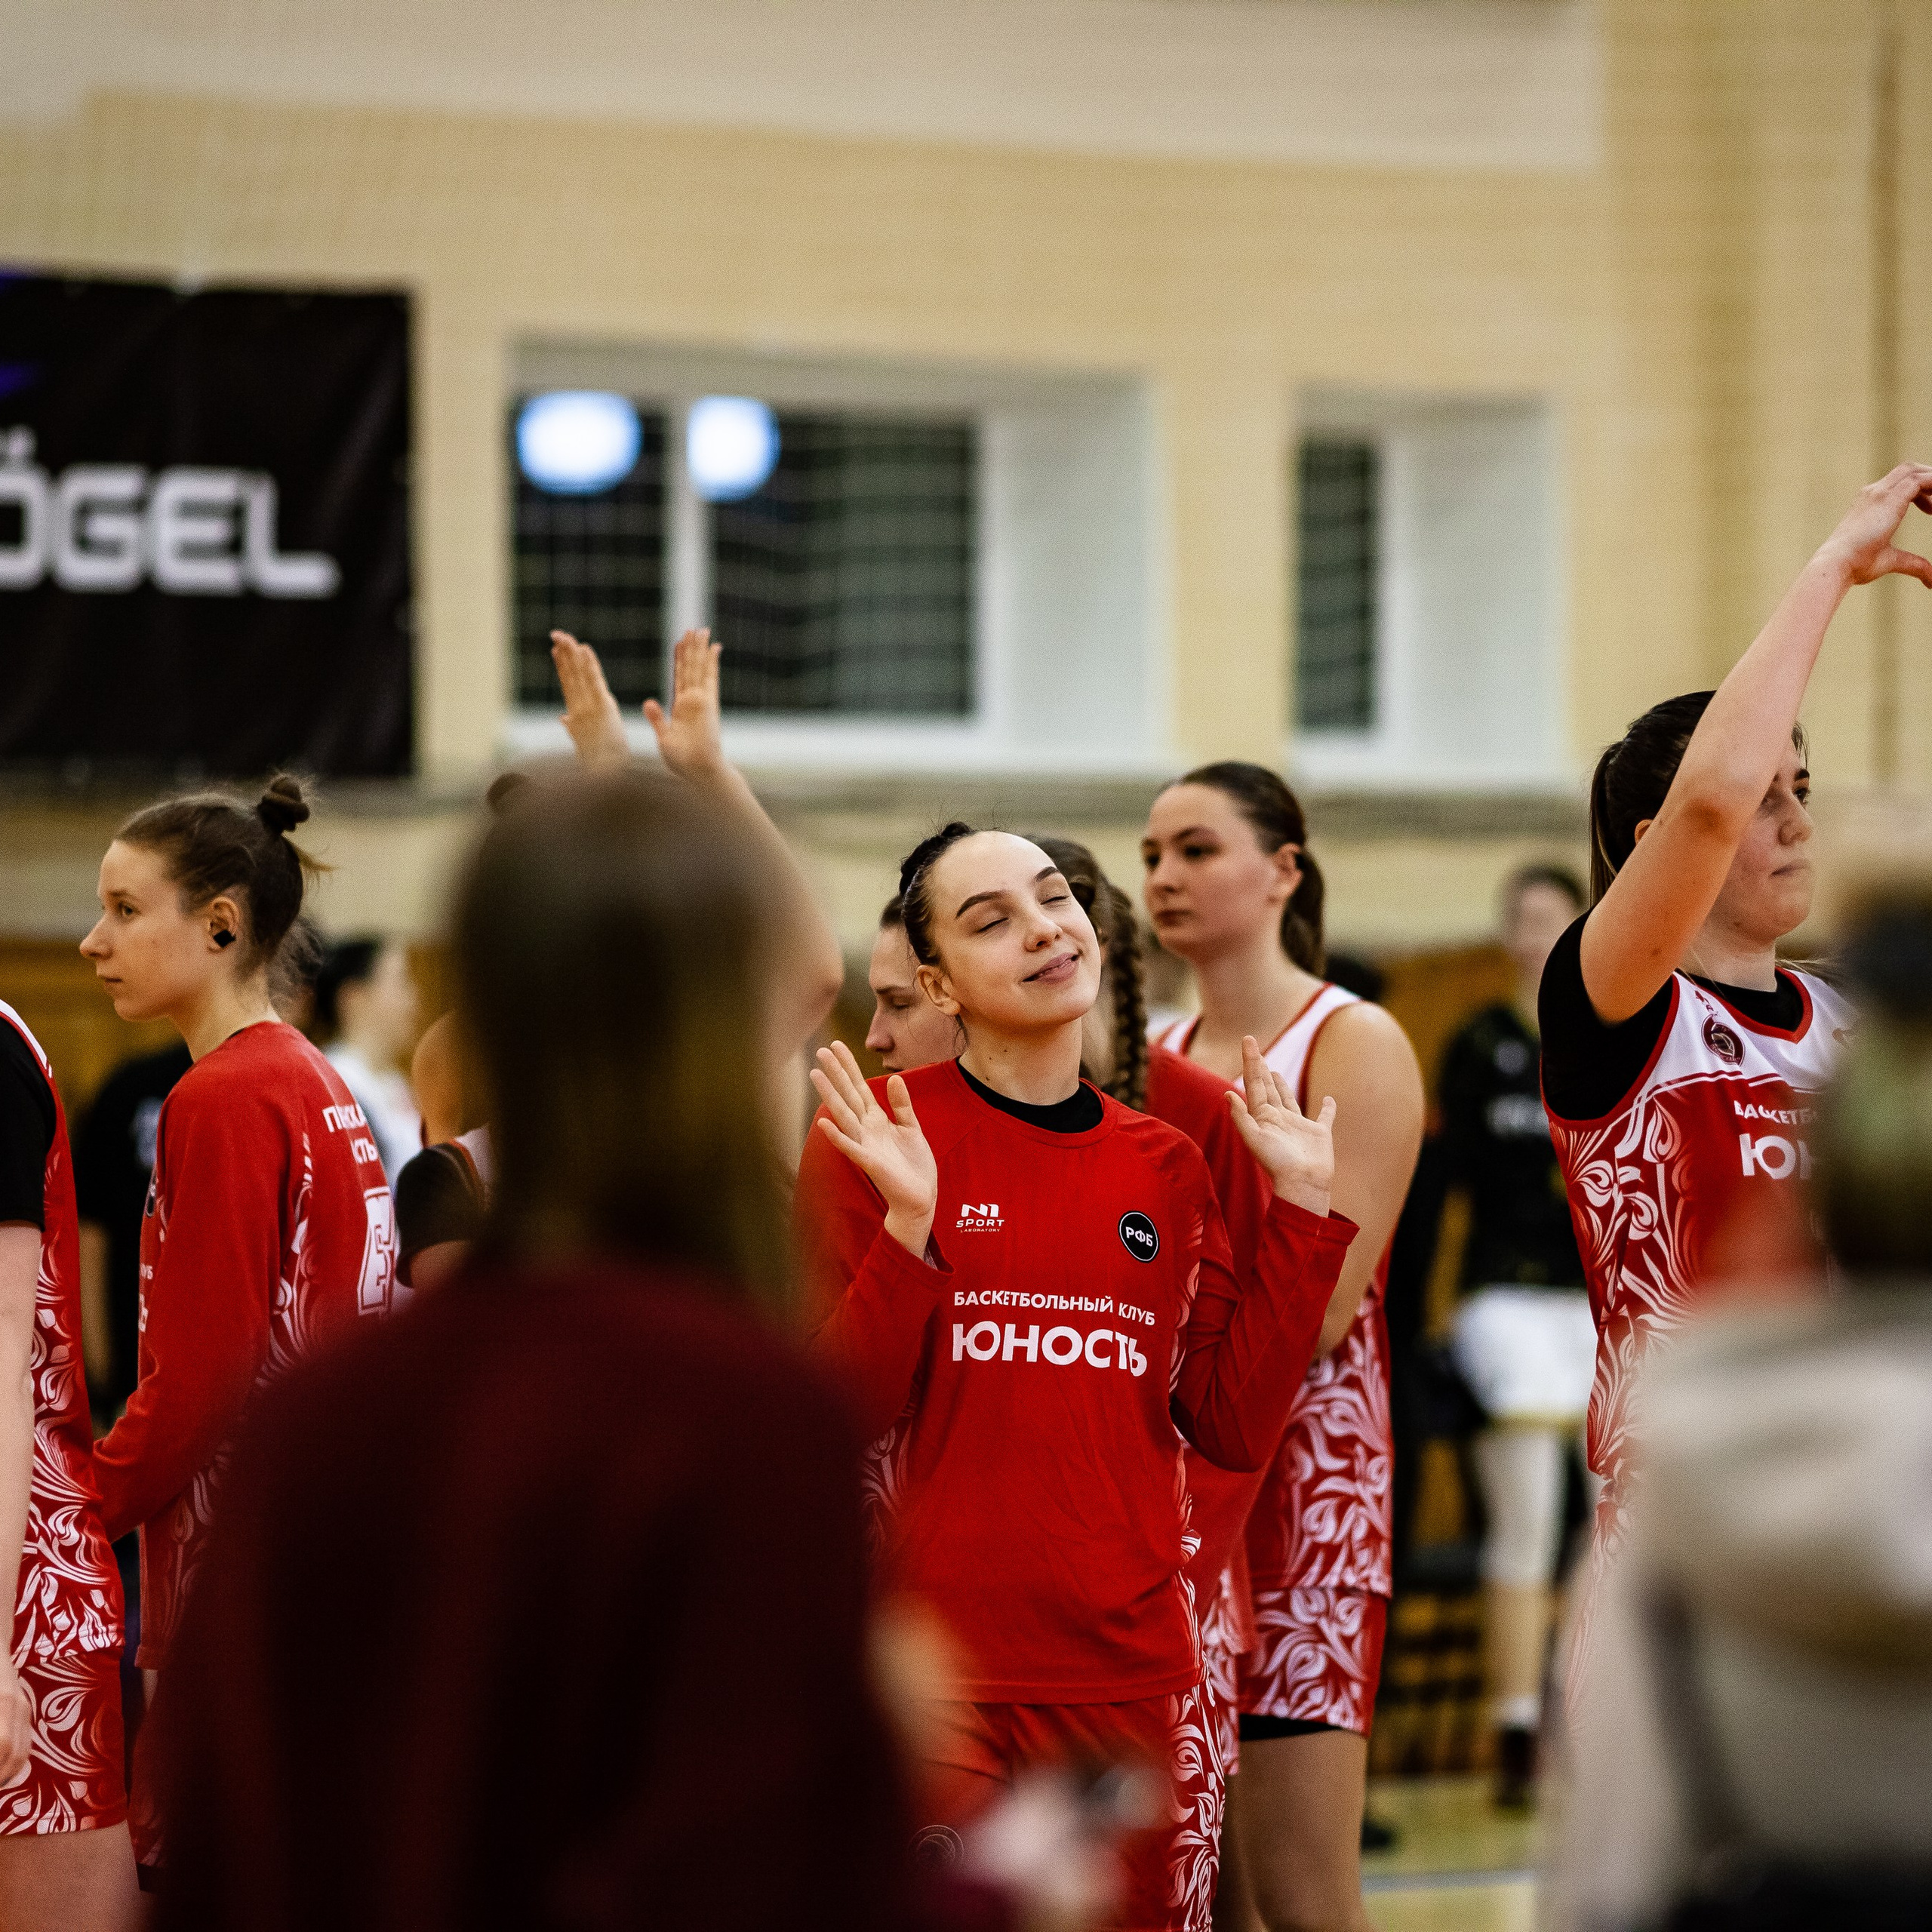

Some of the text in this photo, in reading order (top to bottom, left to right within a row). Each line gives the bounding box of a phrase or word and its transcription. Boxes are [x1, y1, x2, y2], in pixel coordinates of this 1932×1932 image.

[955, 1218, 1004, 1228] SPORT
[1125, 1226, 1153, 1247] РФБ
[954, 1290, 1155, 1326] БАСКЕТБОЛЬНЫЙ КЛУБ
[952, 1321, 1147, 1377] ЮНОСТЬ
